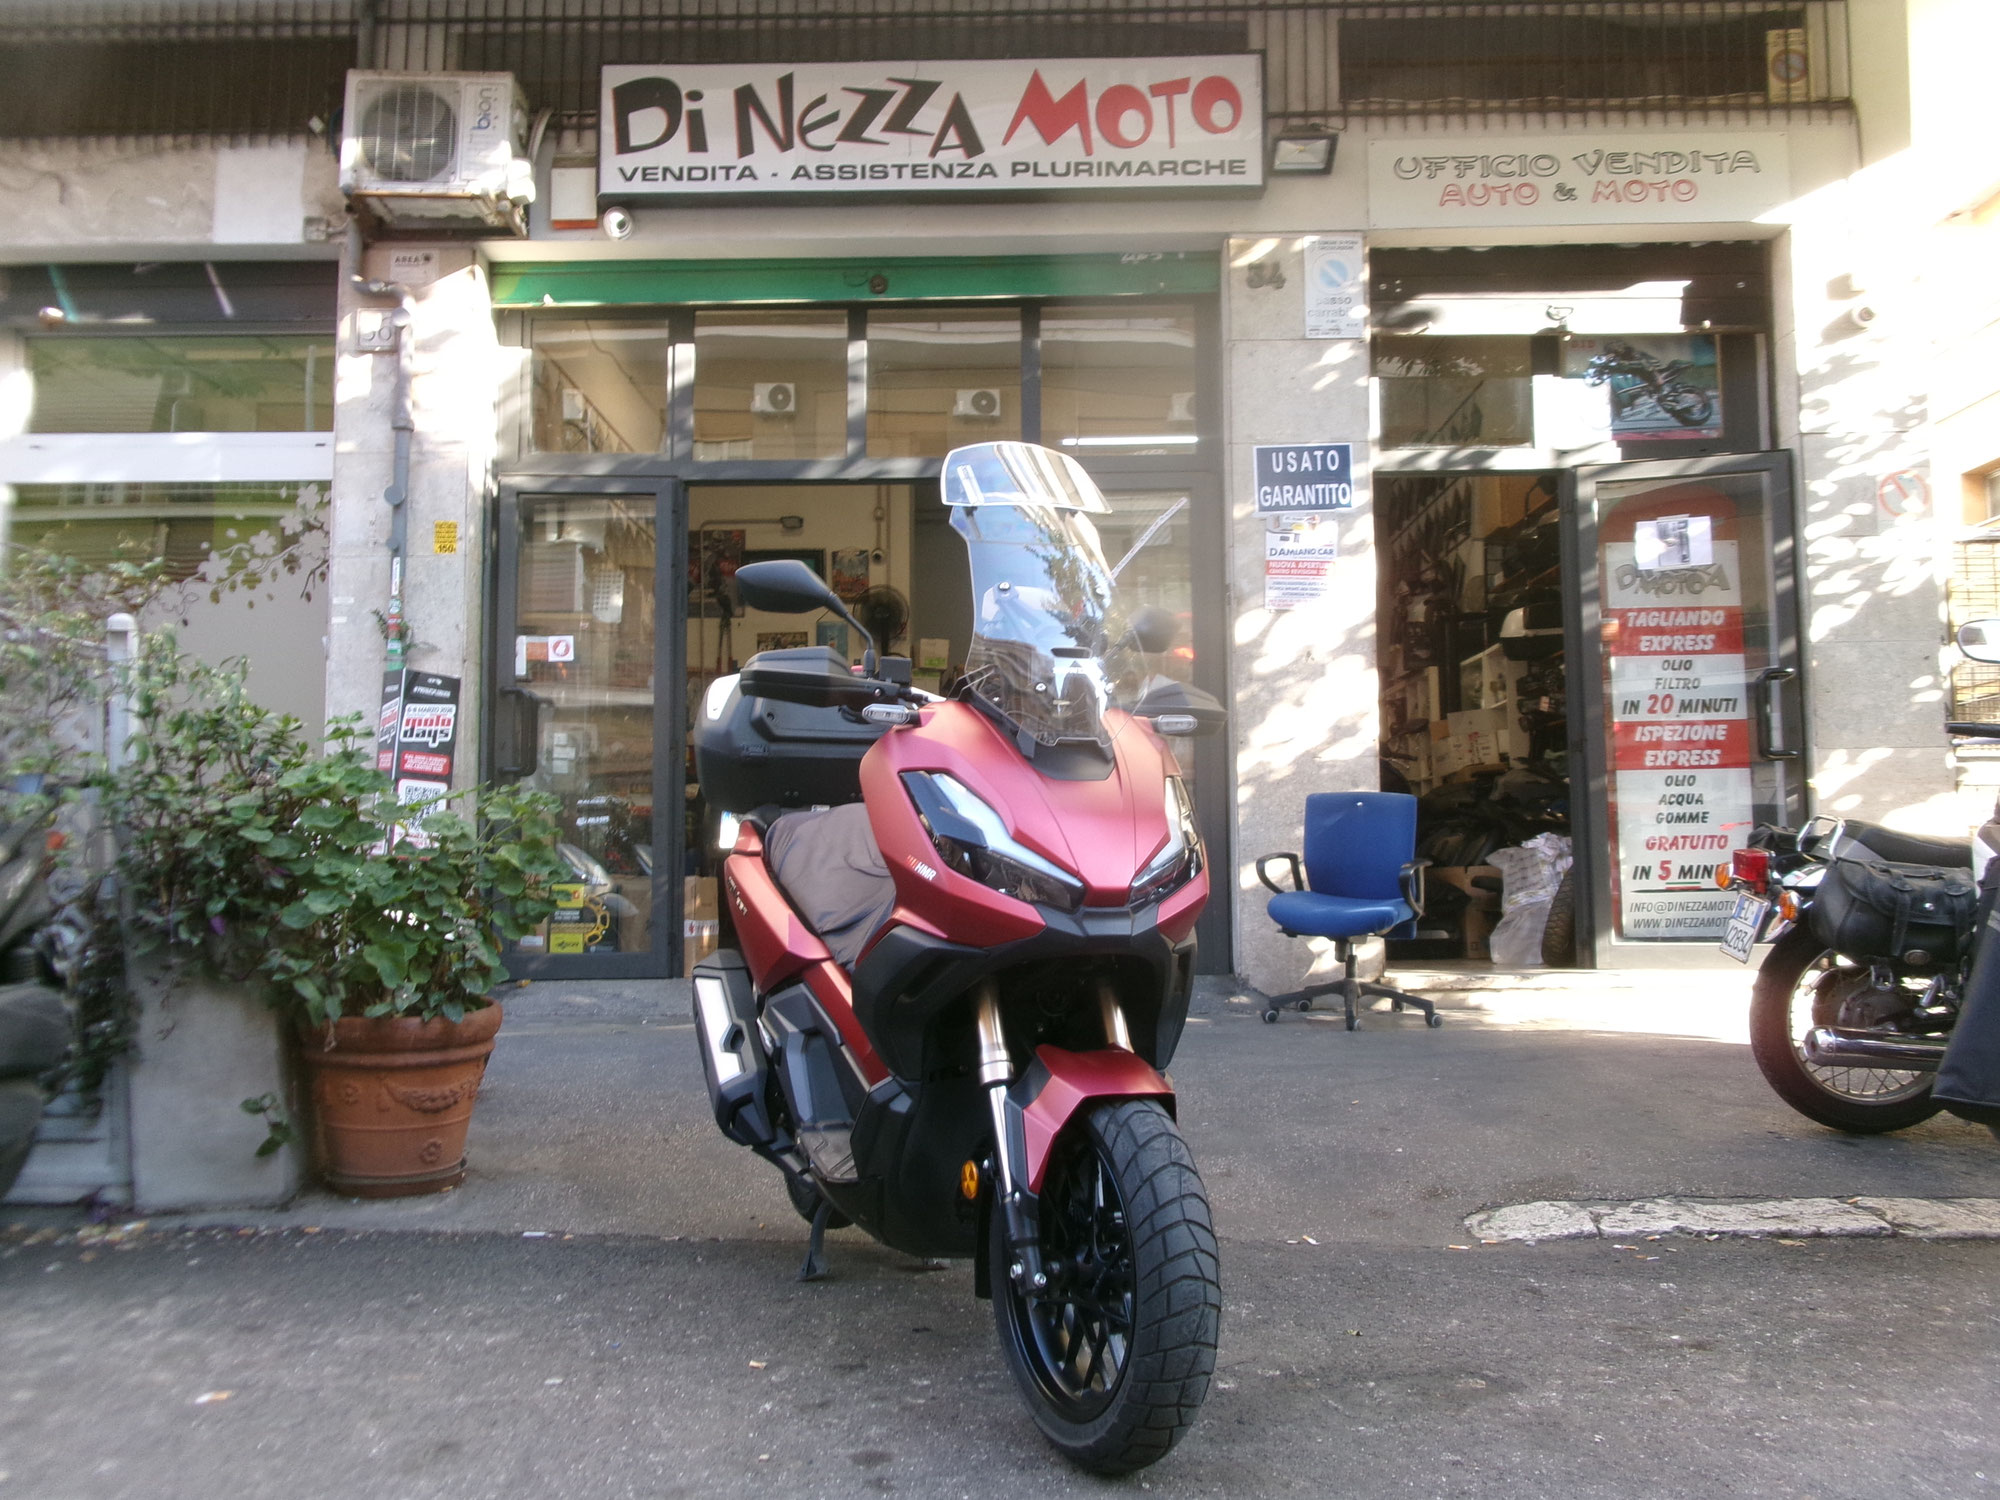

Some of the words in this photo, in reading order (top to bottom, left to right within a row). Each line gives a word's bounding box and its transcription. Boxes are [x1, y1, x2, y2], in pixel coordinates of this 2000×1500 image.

[1002, 68, 1243, 156] MOTO
[618, 164, 758, 182] VENDITA
[791, 162, 998, 181] ASSISTENZA
[1010, 159, 1247, 178] PLURIMARCHE
[1393, 151, 1561, 180] UFFICIO
[1573, 149, 1761, 176] VENDITA
[1439, 182, 1540, 207] AUTO
[1553, 182, 1577, 202] &
[1591, 179, 1698, 204] MOTO
[1271, 450, 1340, 473] USATO
[1259, 483, 1350, 506] GARANTITO
[1269, 548, 1316, 557] DAMIANO
[1317, 548, 1335, 556] CAR
[1626, 611, 1725, 628] TAGLIANDO
[1640, 634, 1716, 652] EXPRESS
[1661, 659, 1693, 671] OLIO
[1655, 677, 1700, 690] FILTRO
[1622, 699, 1640, 715] IN
[1647, 694, 1674, 715] 20
[1679, 698, 1737, 714] MINUTI
[1634, 724, 1728, 742] ISPEZIONE
[1644, 749, 1722, 767] EXPRESS
[1664, 775, 1697, 787] OLIO
[1658, 793, 1704, 806] ACQUA
[1656, 811, 1710, 824] GOMME
[1645, 834, 1729, 852] GRATUITO
[1632, 865, 1652, 880] IN
[1658, 860, 1672, 880] 5
[1677, 864, 1717, 880] MIN
[1633, 916, 1731, 929] WWW.DINEZZAMOT
